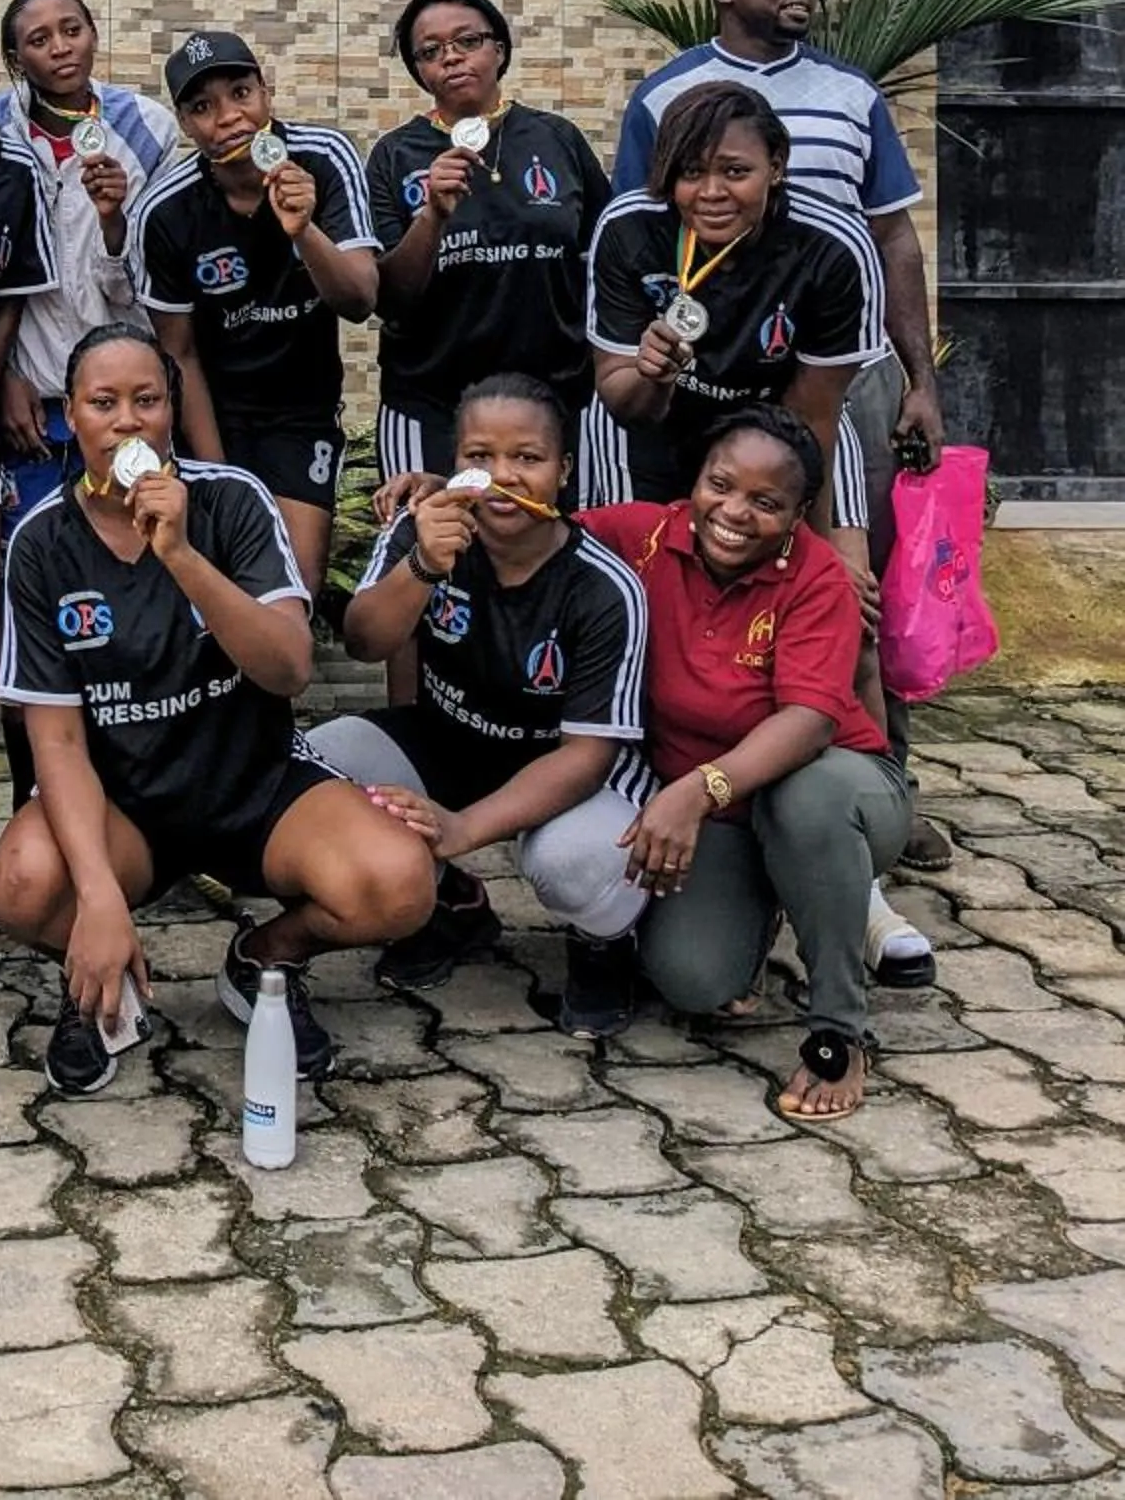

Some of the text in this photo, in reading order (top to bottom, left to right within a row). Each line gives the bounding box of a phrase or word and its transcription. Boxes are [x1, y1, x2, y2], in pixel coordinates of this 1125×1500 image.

[196, 256, 250, 286] OPS
[438, 244, 529, 272] PRESSING
[308, 440, 334, 485] 8
[58, 603, 115, 637] OPS
[92, 688, 202, 727] RESSING
